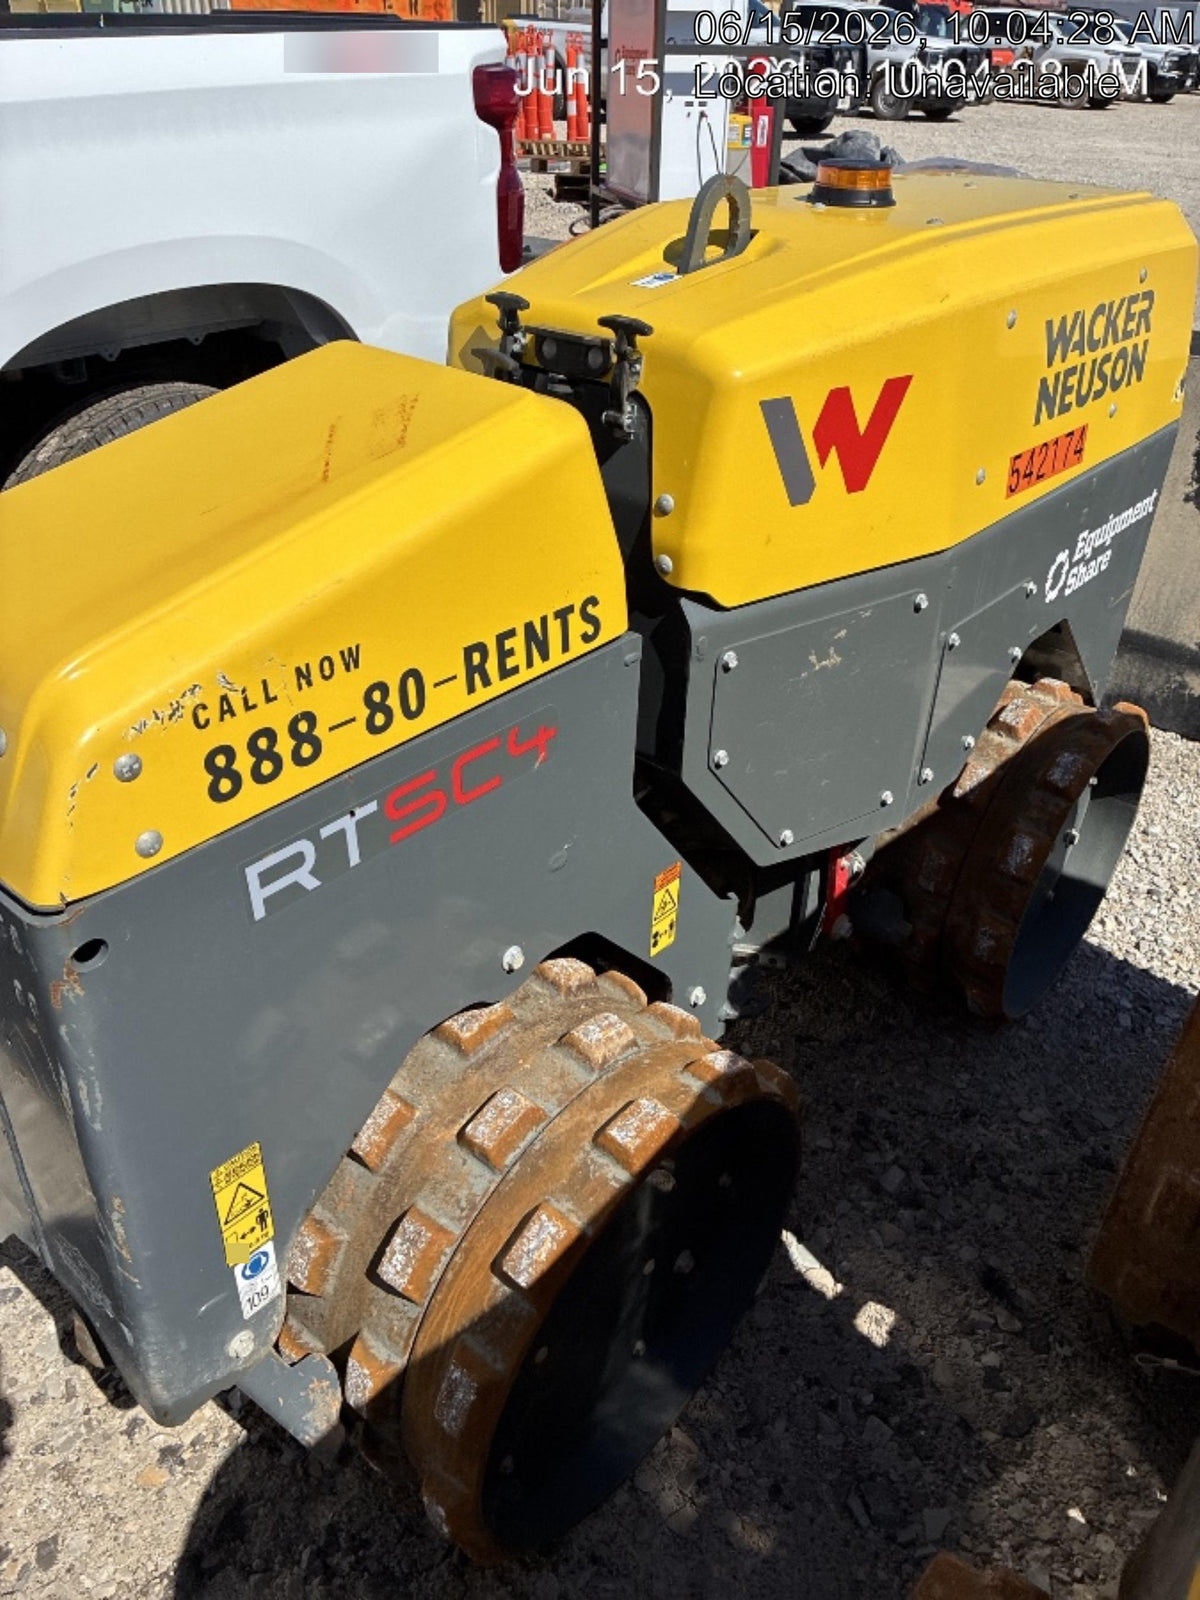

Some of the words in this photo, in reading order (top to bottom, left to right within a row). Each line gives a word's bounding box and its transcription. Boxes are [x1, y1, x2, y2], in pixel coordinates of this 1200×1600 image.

[1045, 289, 1155, 368] WACKER
[1033, 340, 1149, 426] NEUSON
[1008, 424, 1086, 494] 542174
[1073, 490, 1158, 562] Equipment
[1065, 549, 1112, 597] Share
[192, 678, 278, 730] CALL
[294, 644, 362, 692] NOW
[203, 596, 602, 803] 888-80-RENTS
